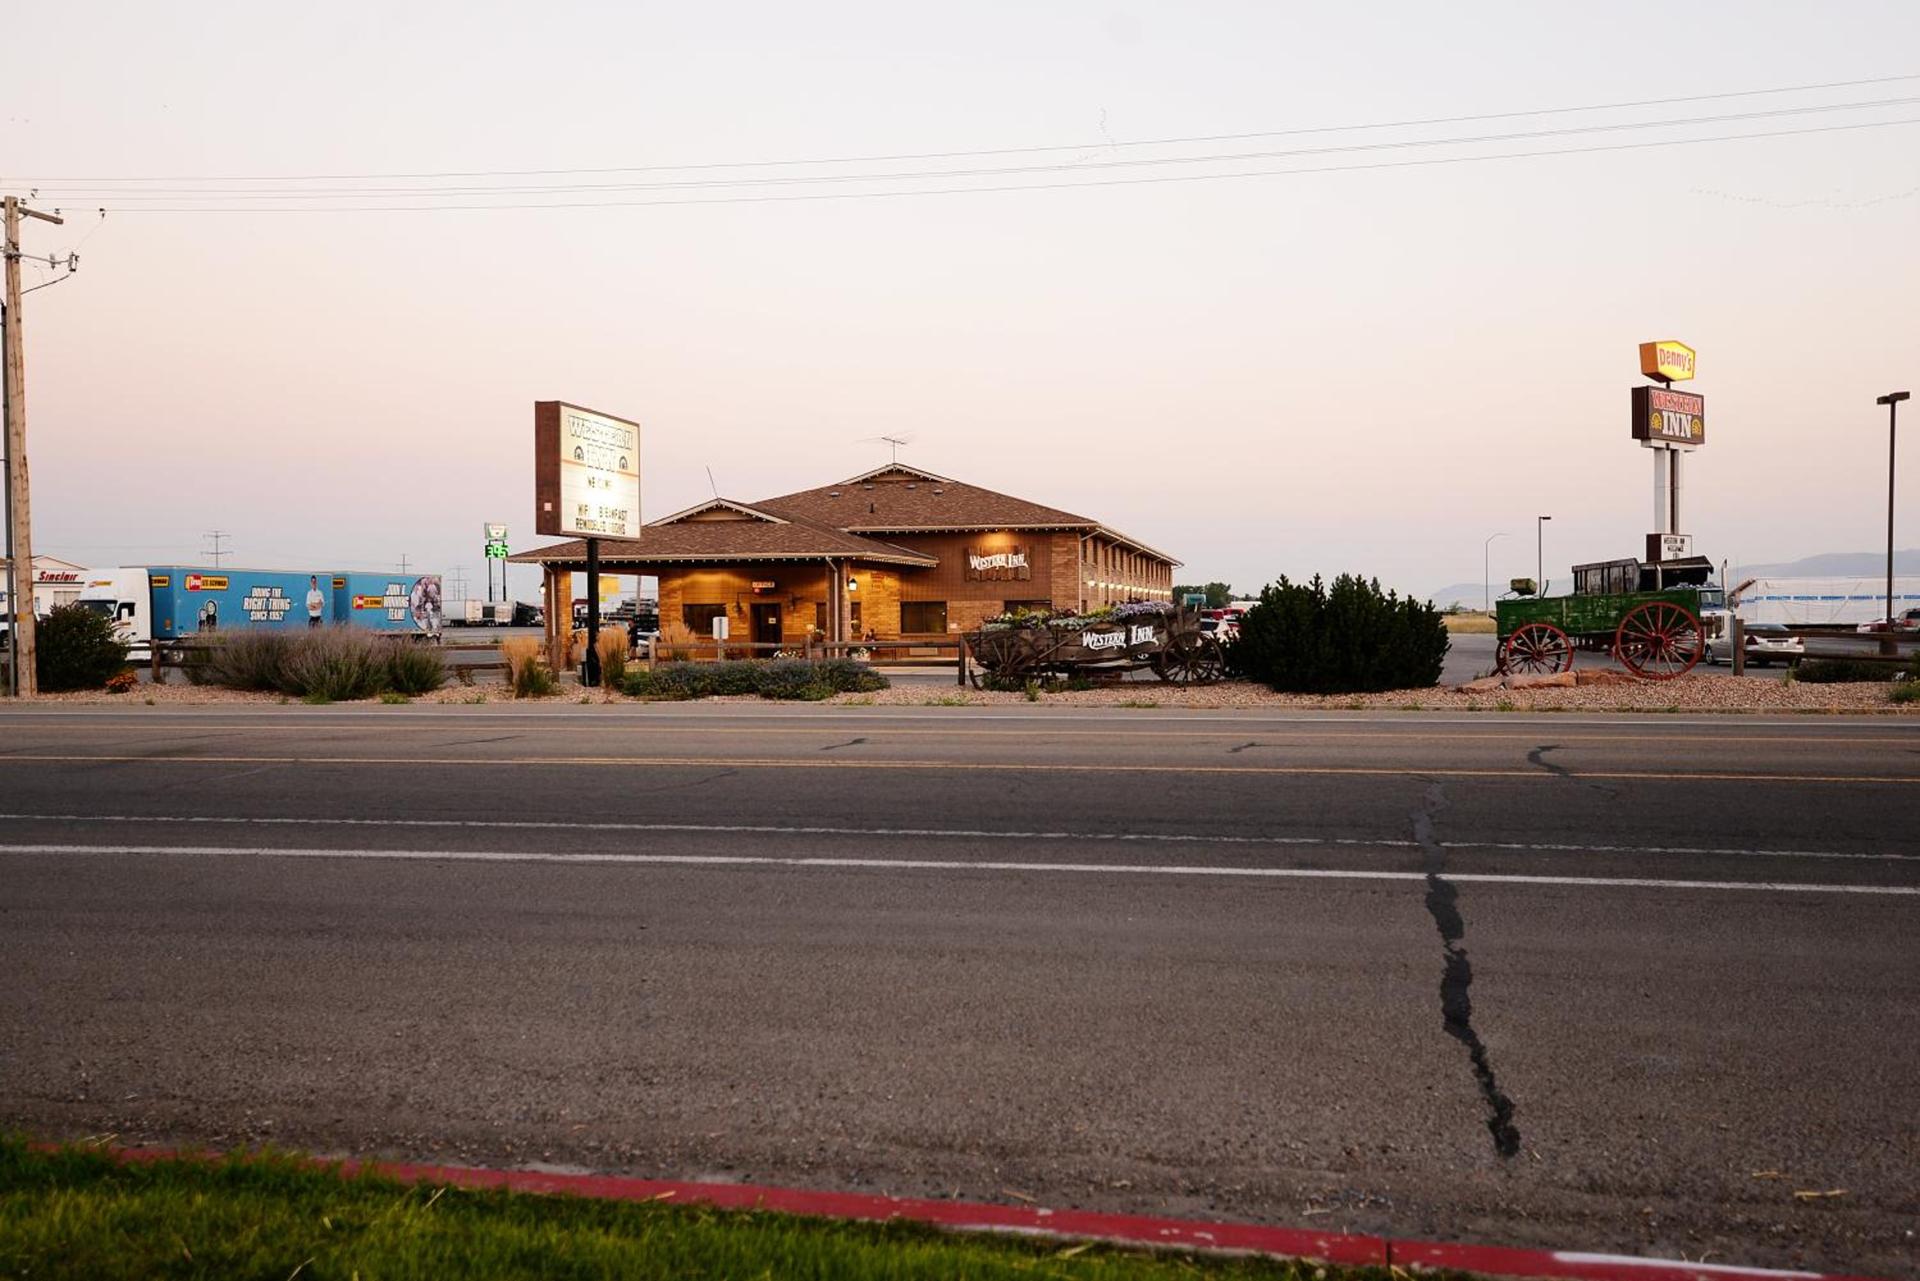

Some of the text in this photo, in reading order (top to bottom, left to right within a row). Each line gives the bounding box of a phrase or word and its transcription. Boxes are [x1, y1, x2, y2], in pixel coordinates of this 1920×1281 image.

[1659, 348, 1692, 371] Denny's
[1651, 389, 1703, 416] WESTERN
[1662, 410, 1692, 439] INN
[39, 571, 78, 582] Sinclair
[243, 597, 291, 610] RIGHT THING
[1082, 624, 1160, 651] WESTERN INN
